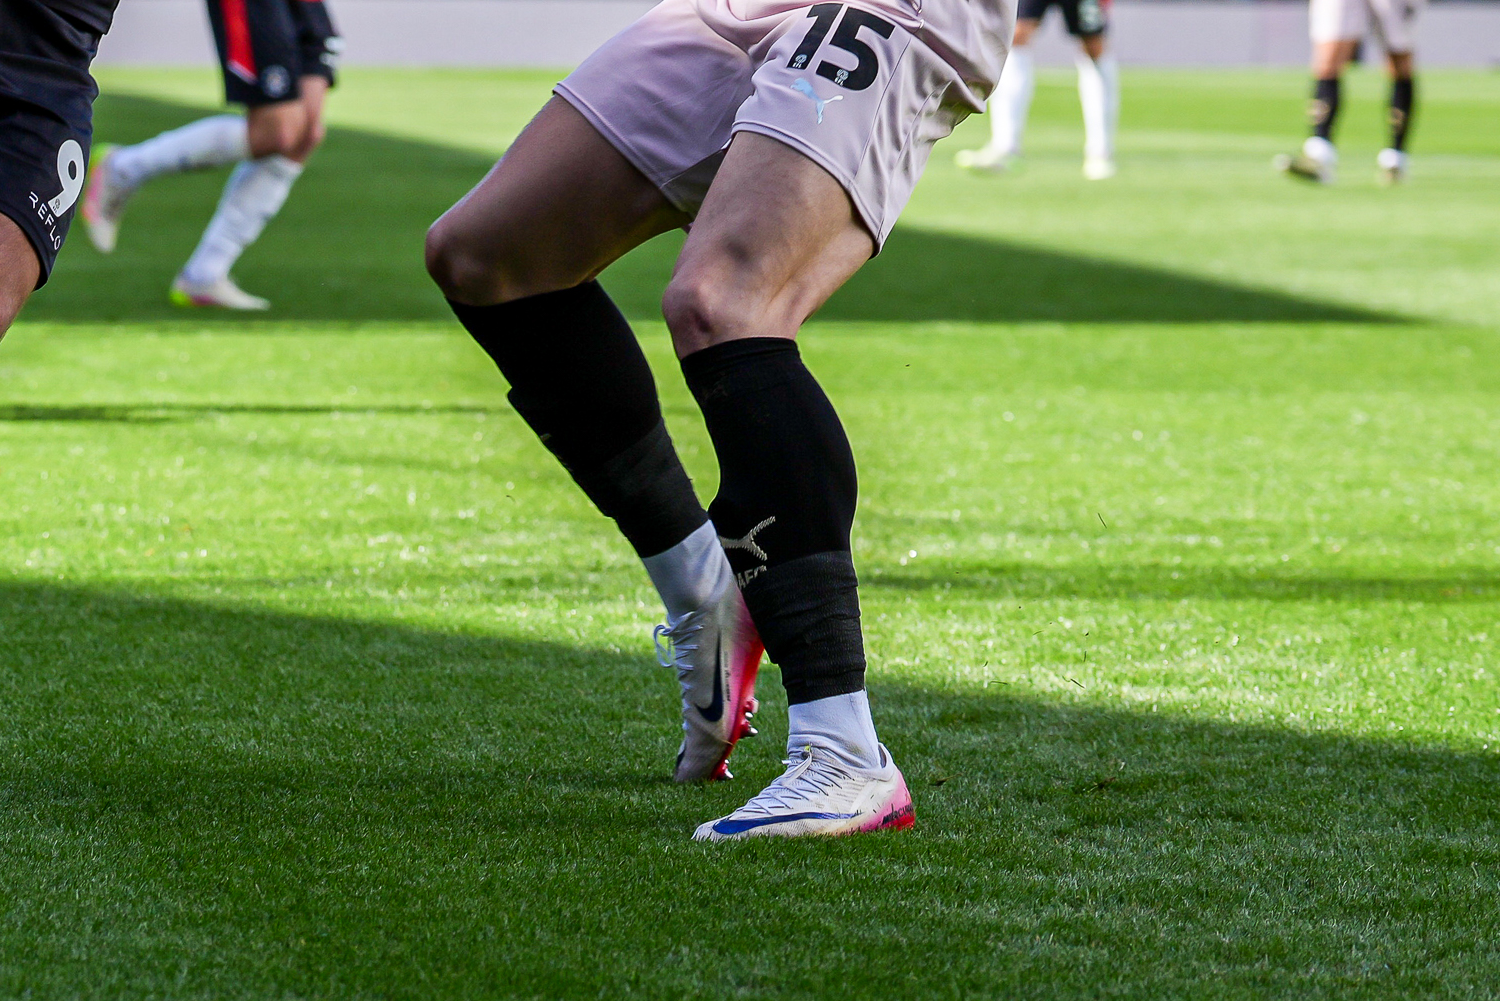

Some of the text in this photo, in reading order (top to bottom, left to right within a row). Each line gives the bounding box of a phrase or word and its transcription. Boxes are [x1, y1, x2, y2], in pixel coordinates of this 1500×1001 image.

[786, 2, 896, 91] 15
[47, 139, 85, 218] 9
[28, 191, 61, 250] REFLO
